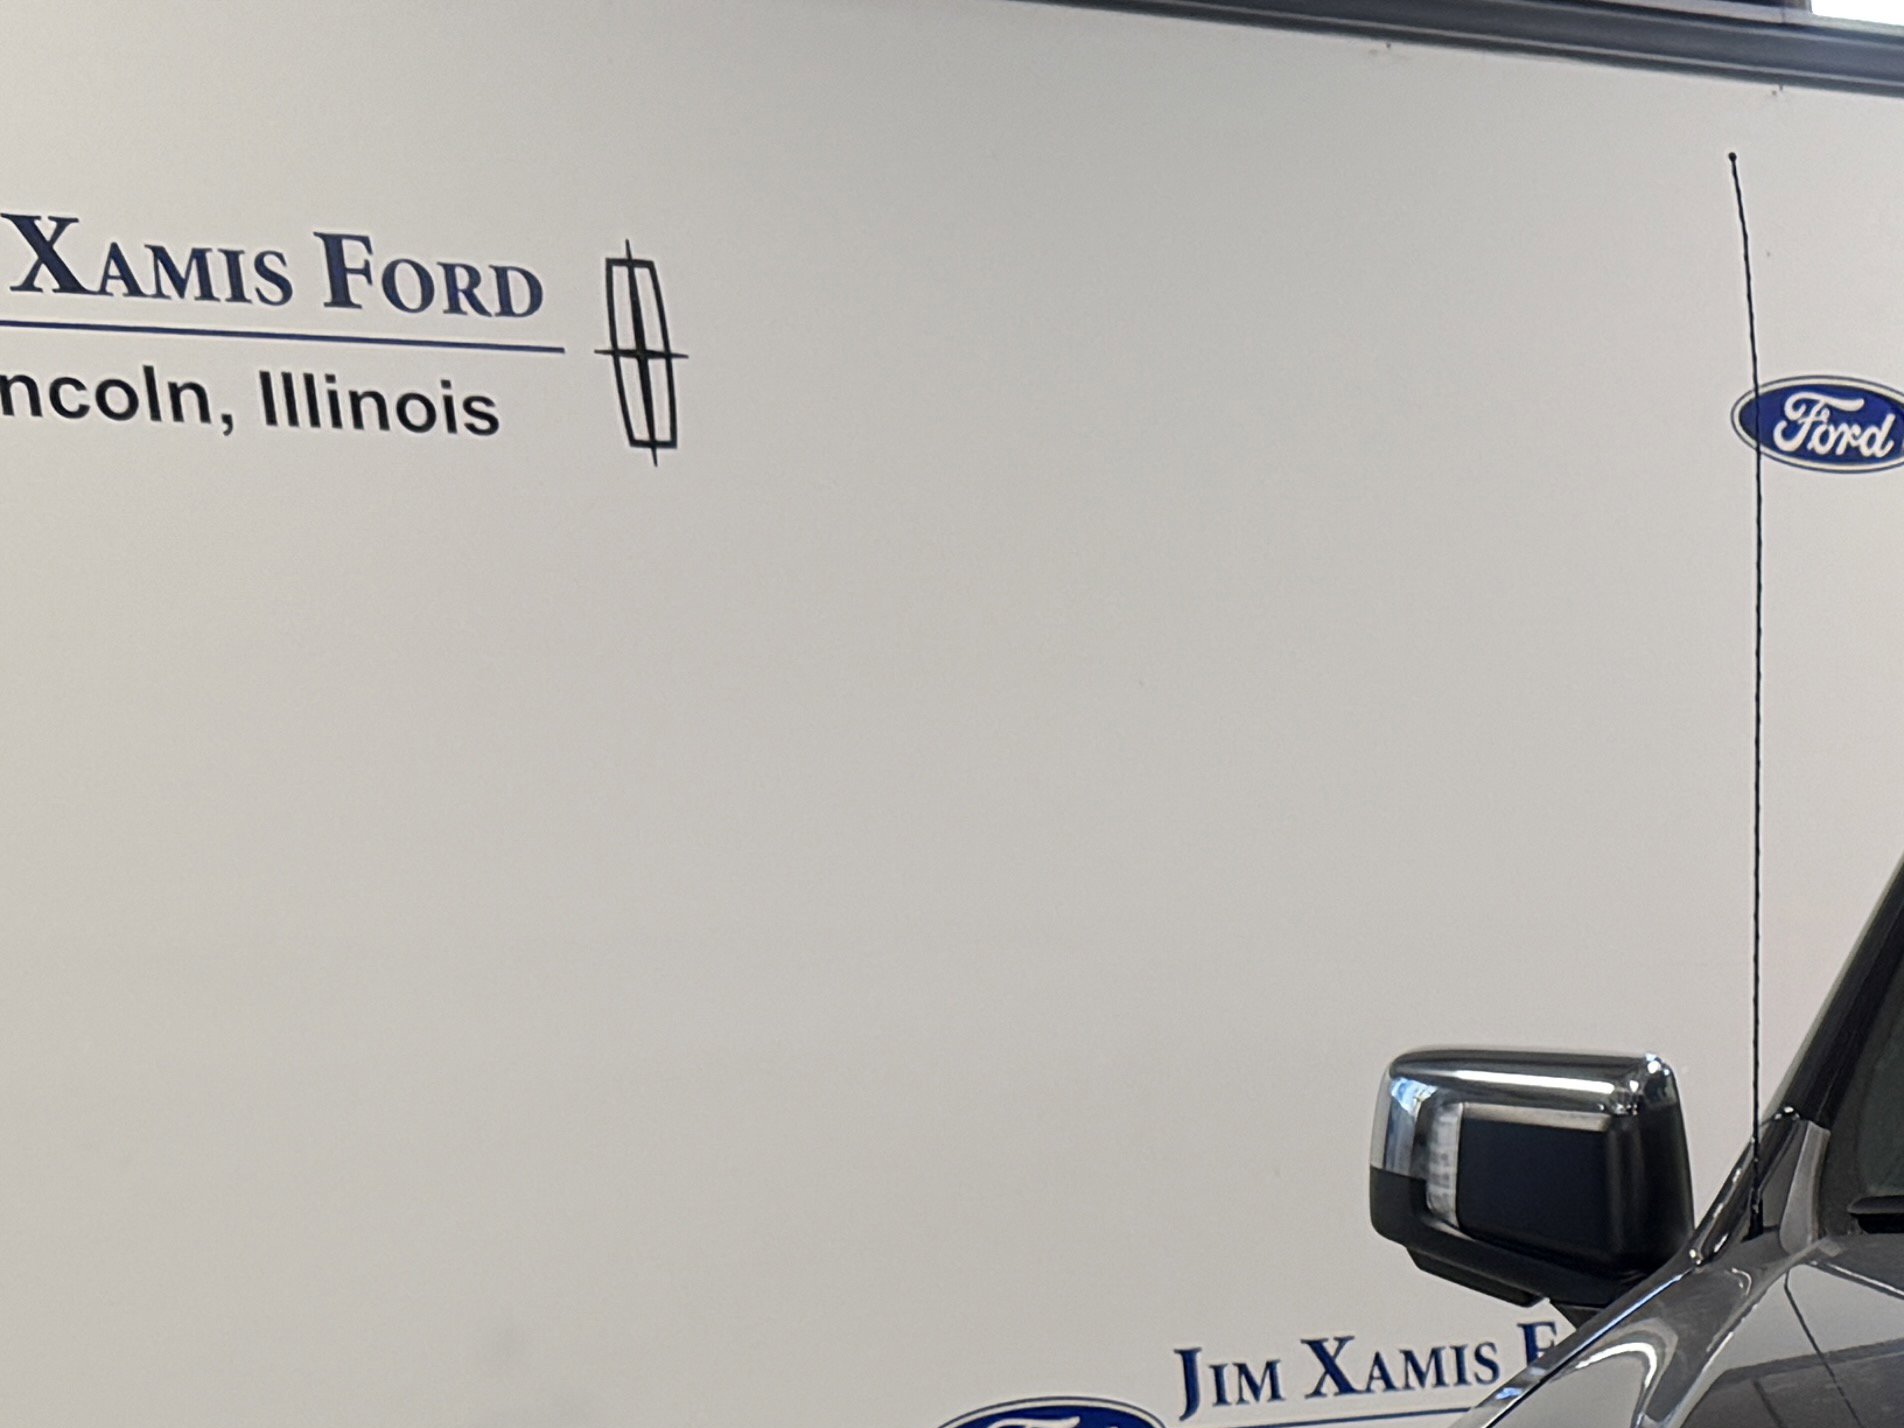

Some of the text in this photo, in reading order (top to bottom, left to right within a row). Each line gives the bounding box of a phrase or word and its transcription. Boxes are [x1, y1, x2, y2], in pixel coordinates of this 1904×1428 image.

[0, 212, 544, 318] XAMIS FORD
[0, 364, 500, 437] ncoln, Illinois
[1772, 391, 1898, 460] Ford
[1173, 1347, 1284, 1422] JIM
[1300, 1335, 1500, 1399] XAMIS
